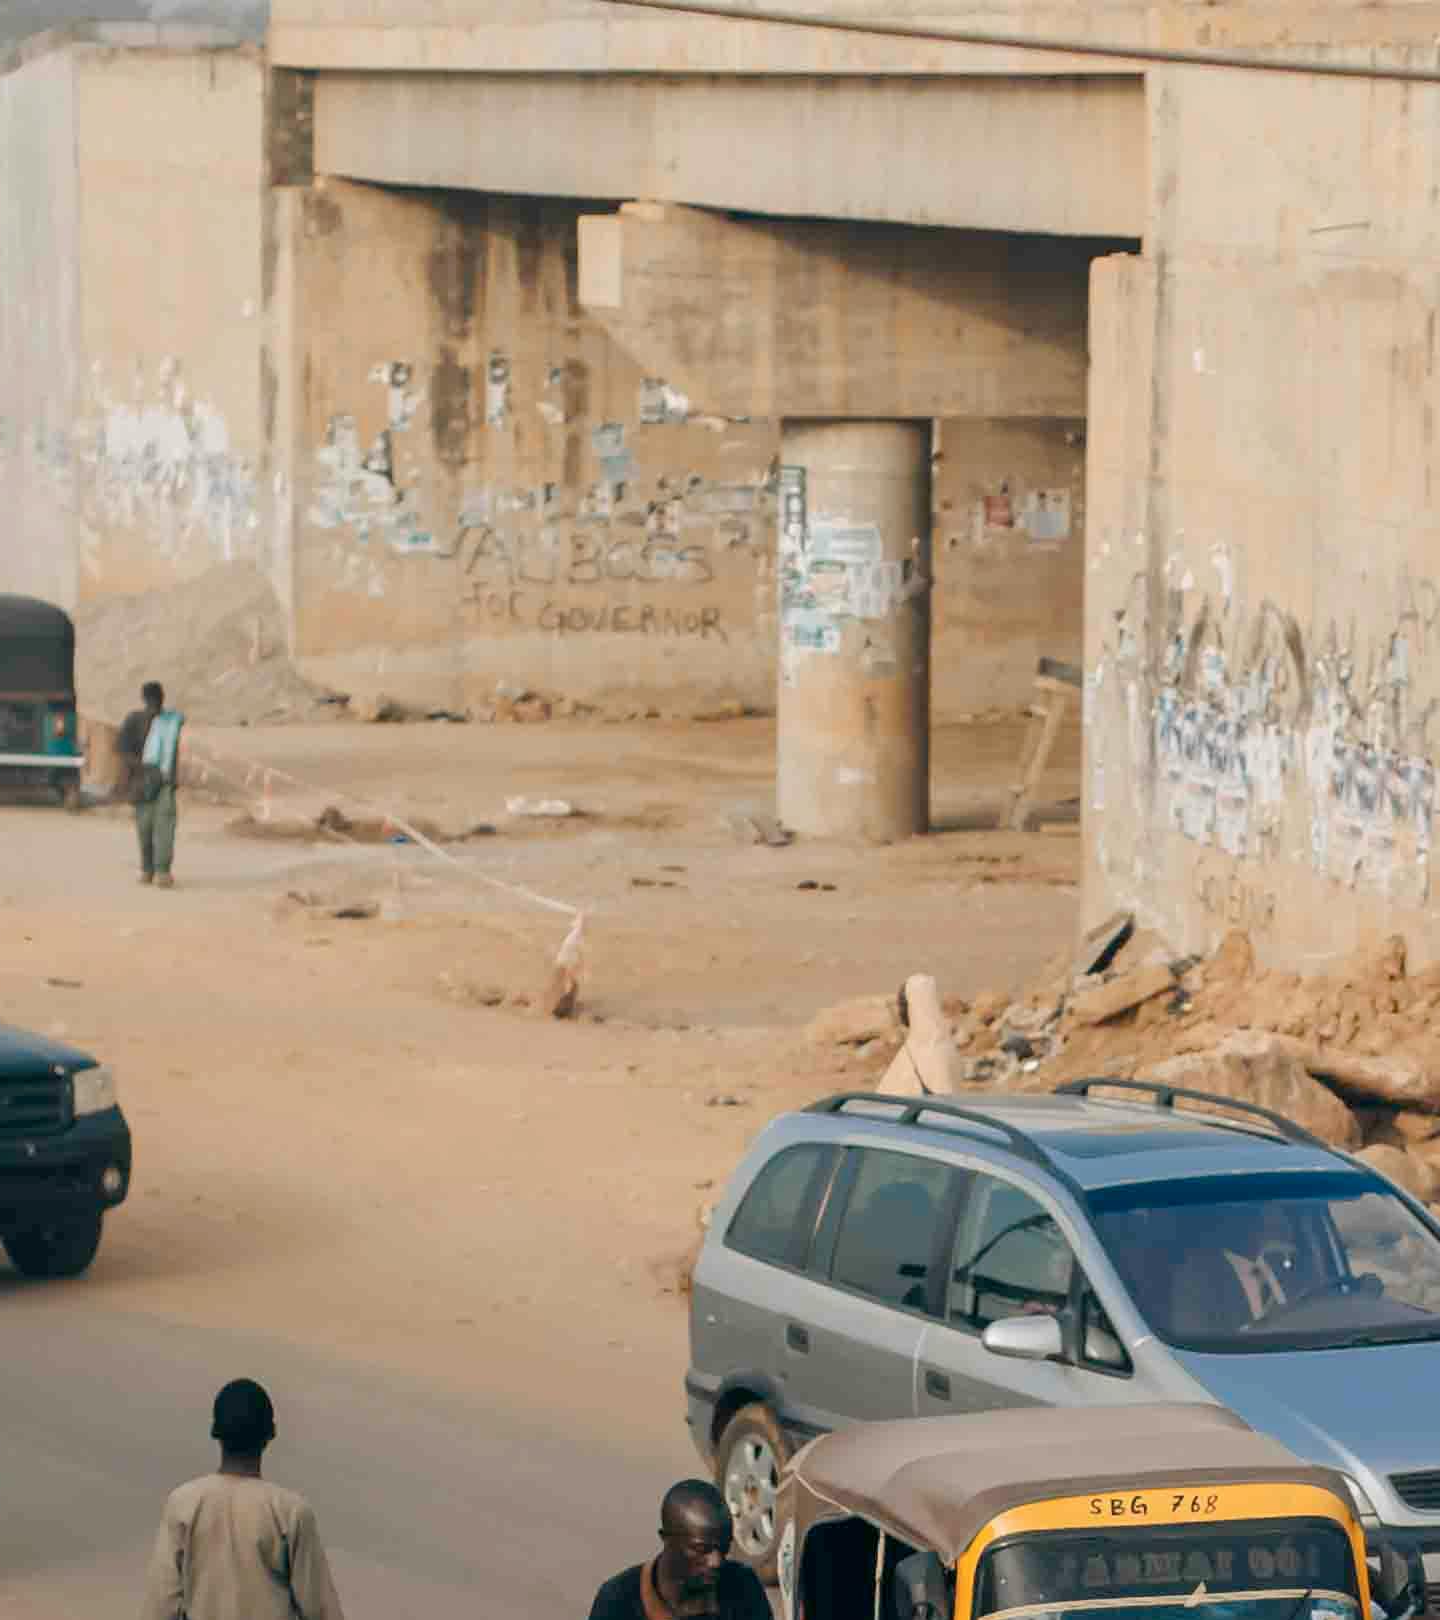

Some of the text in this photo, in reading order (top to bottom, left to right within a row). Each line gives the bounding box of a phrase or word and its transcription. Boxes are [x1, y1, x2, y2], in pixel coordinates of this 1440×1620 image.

[538, 602, 728, 643] GOVERNOR
[1090, 1495, 1219, 1515] SBG 768
